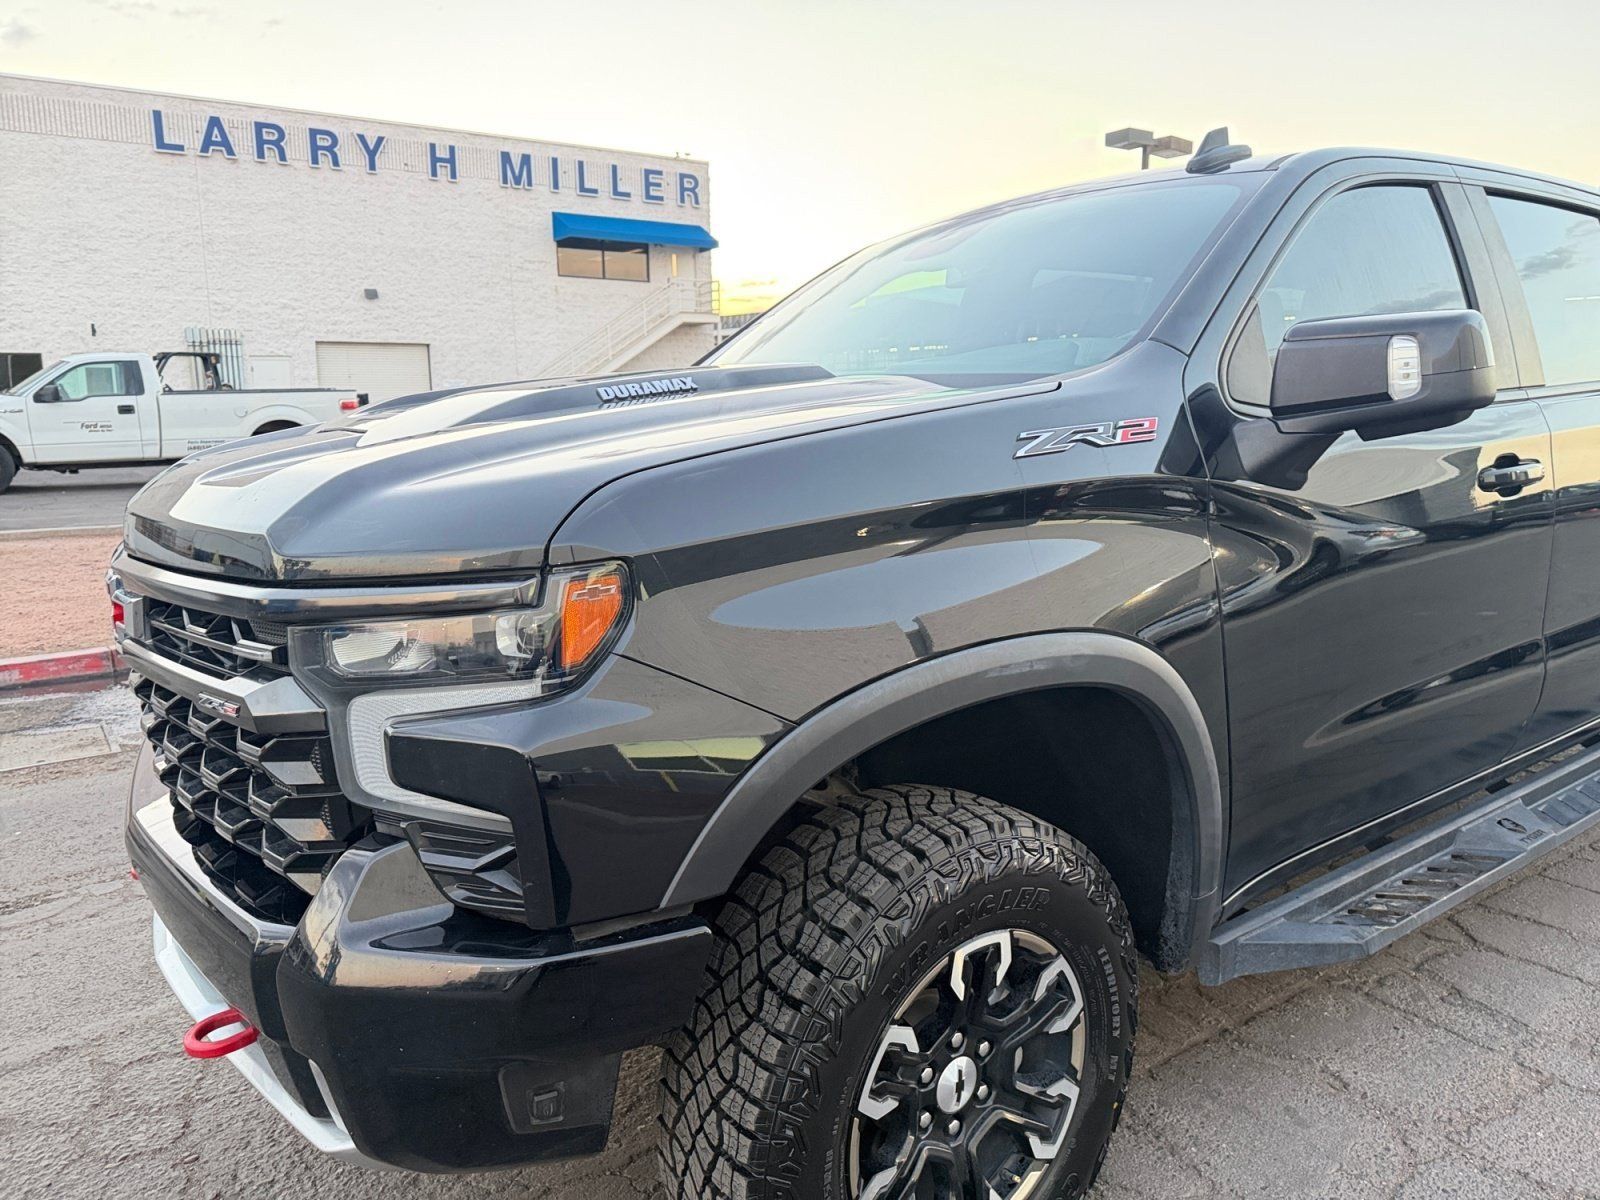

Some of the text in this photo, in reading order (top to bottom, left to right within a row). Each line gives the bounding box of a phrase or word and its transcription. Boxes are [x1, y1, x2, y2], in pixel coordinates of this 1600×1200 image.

[151, 108, 701, 208] LARRY H MILLER
[597, 376, 699, 402] DURAMAX
[80, 422, 98, 430] Ford
[1012, 416, 1159, 460] ZR2
[198, 691, 241, 718] ZR2
[1097, 943, 1122, 1039] TERRITORY
